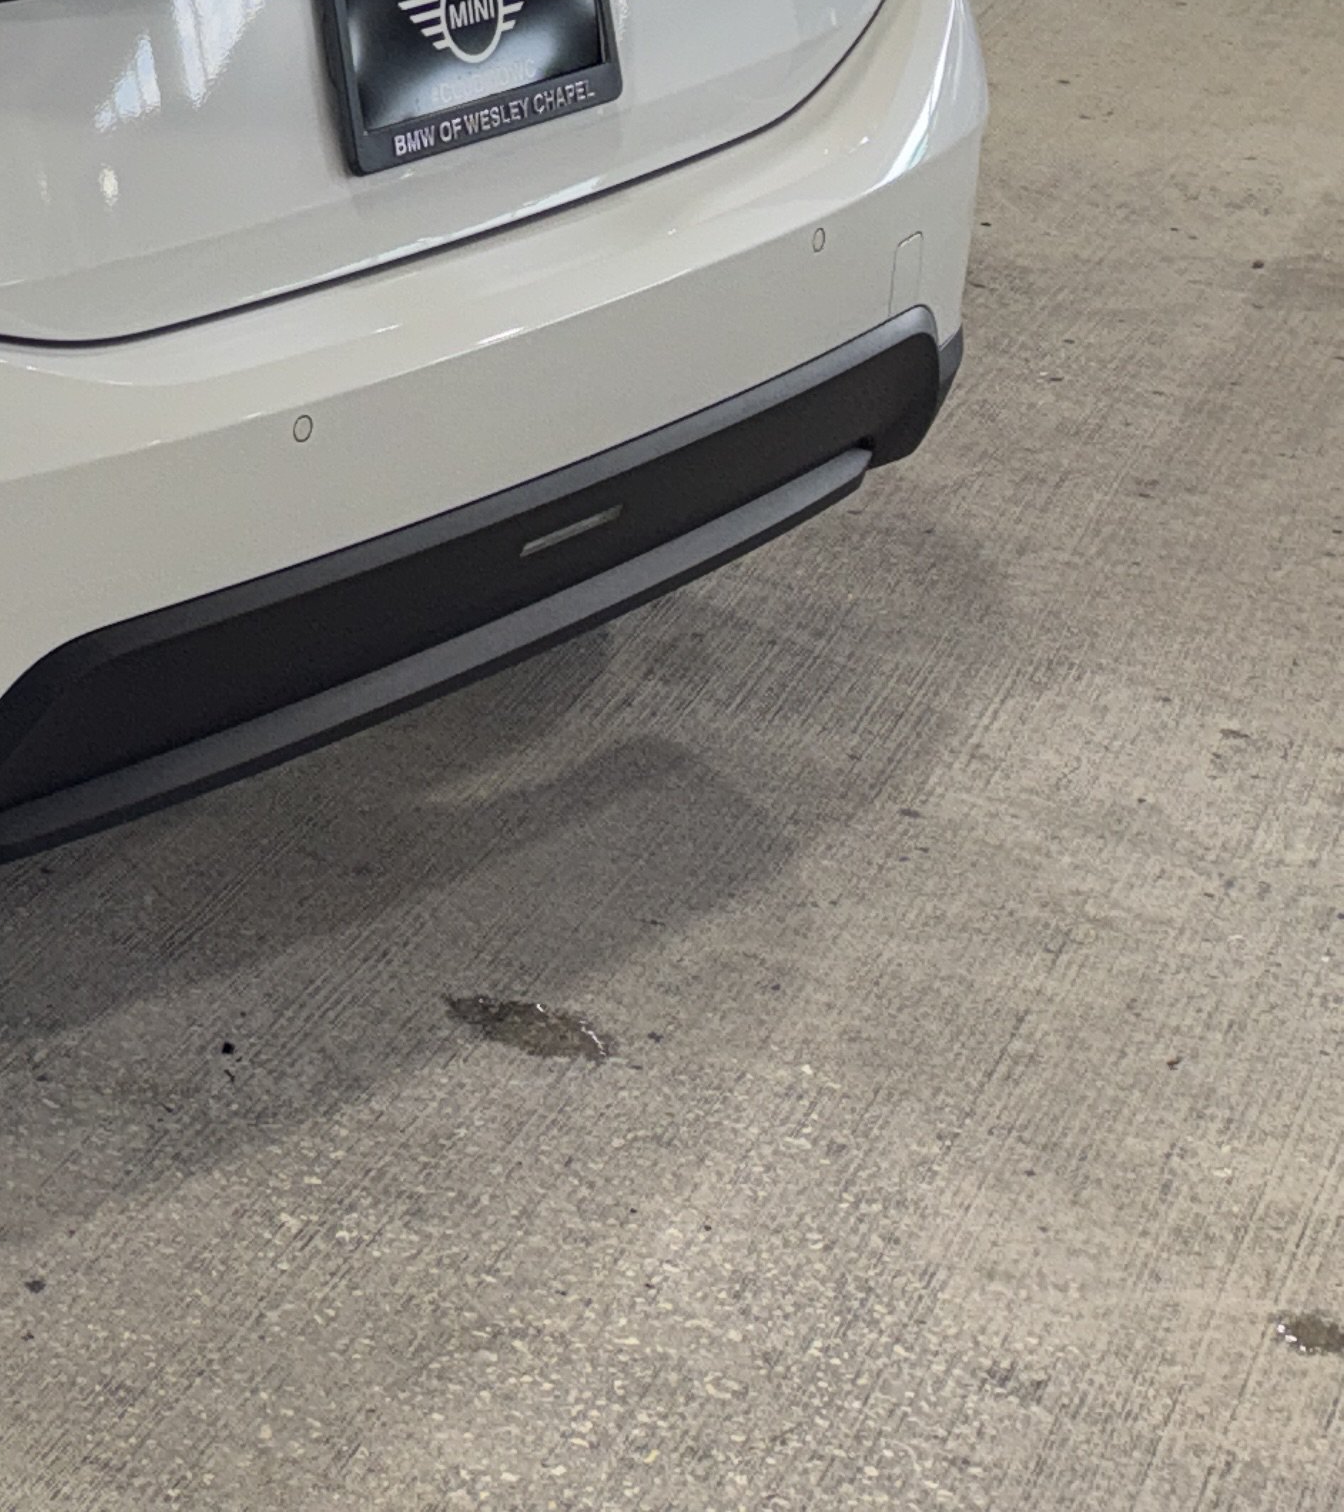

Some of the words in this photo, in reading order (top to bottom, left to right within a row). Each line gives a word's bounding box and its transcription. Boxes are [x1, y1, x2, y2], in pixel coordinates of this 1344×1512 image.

[394, 125, 435, 157] BMW
[439, 118, 462, 143] OF
[463, 96, 530, 136] WESLEY
[533, 80, 596, 114] CHAPEL
